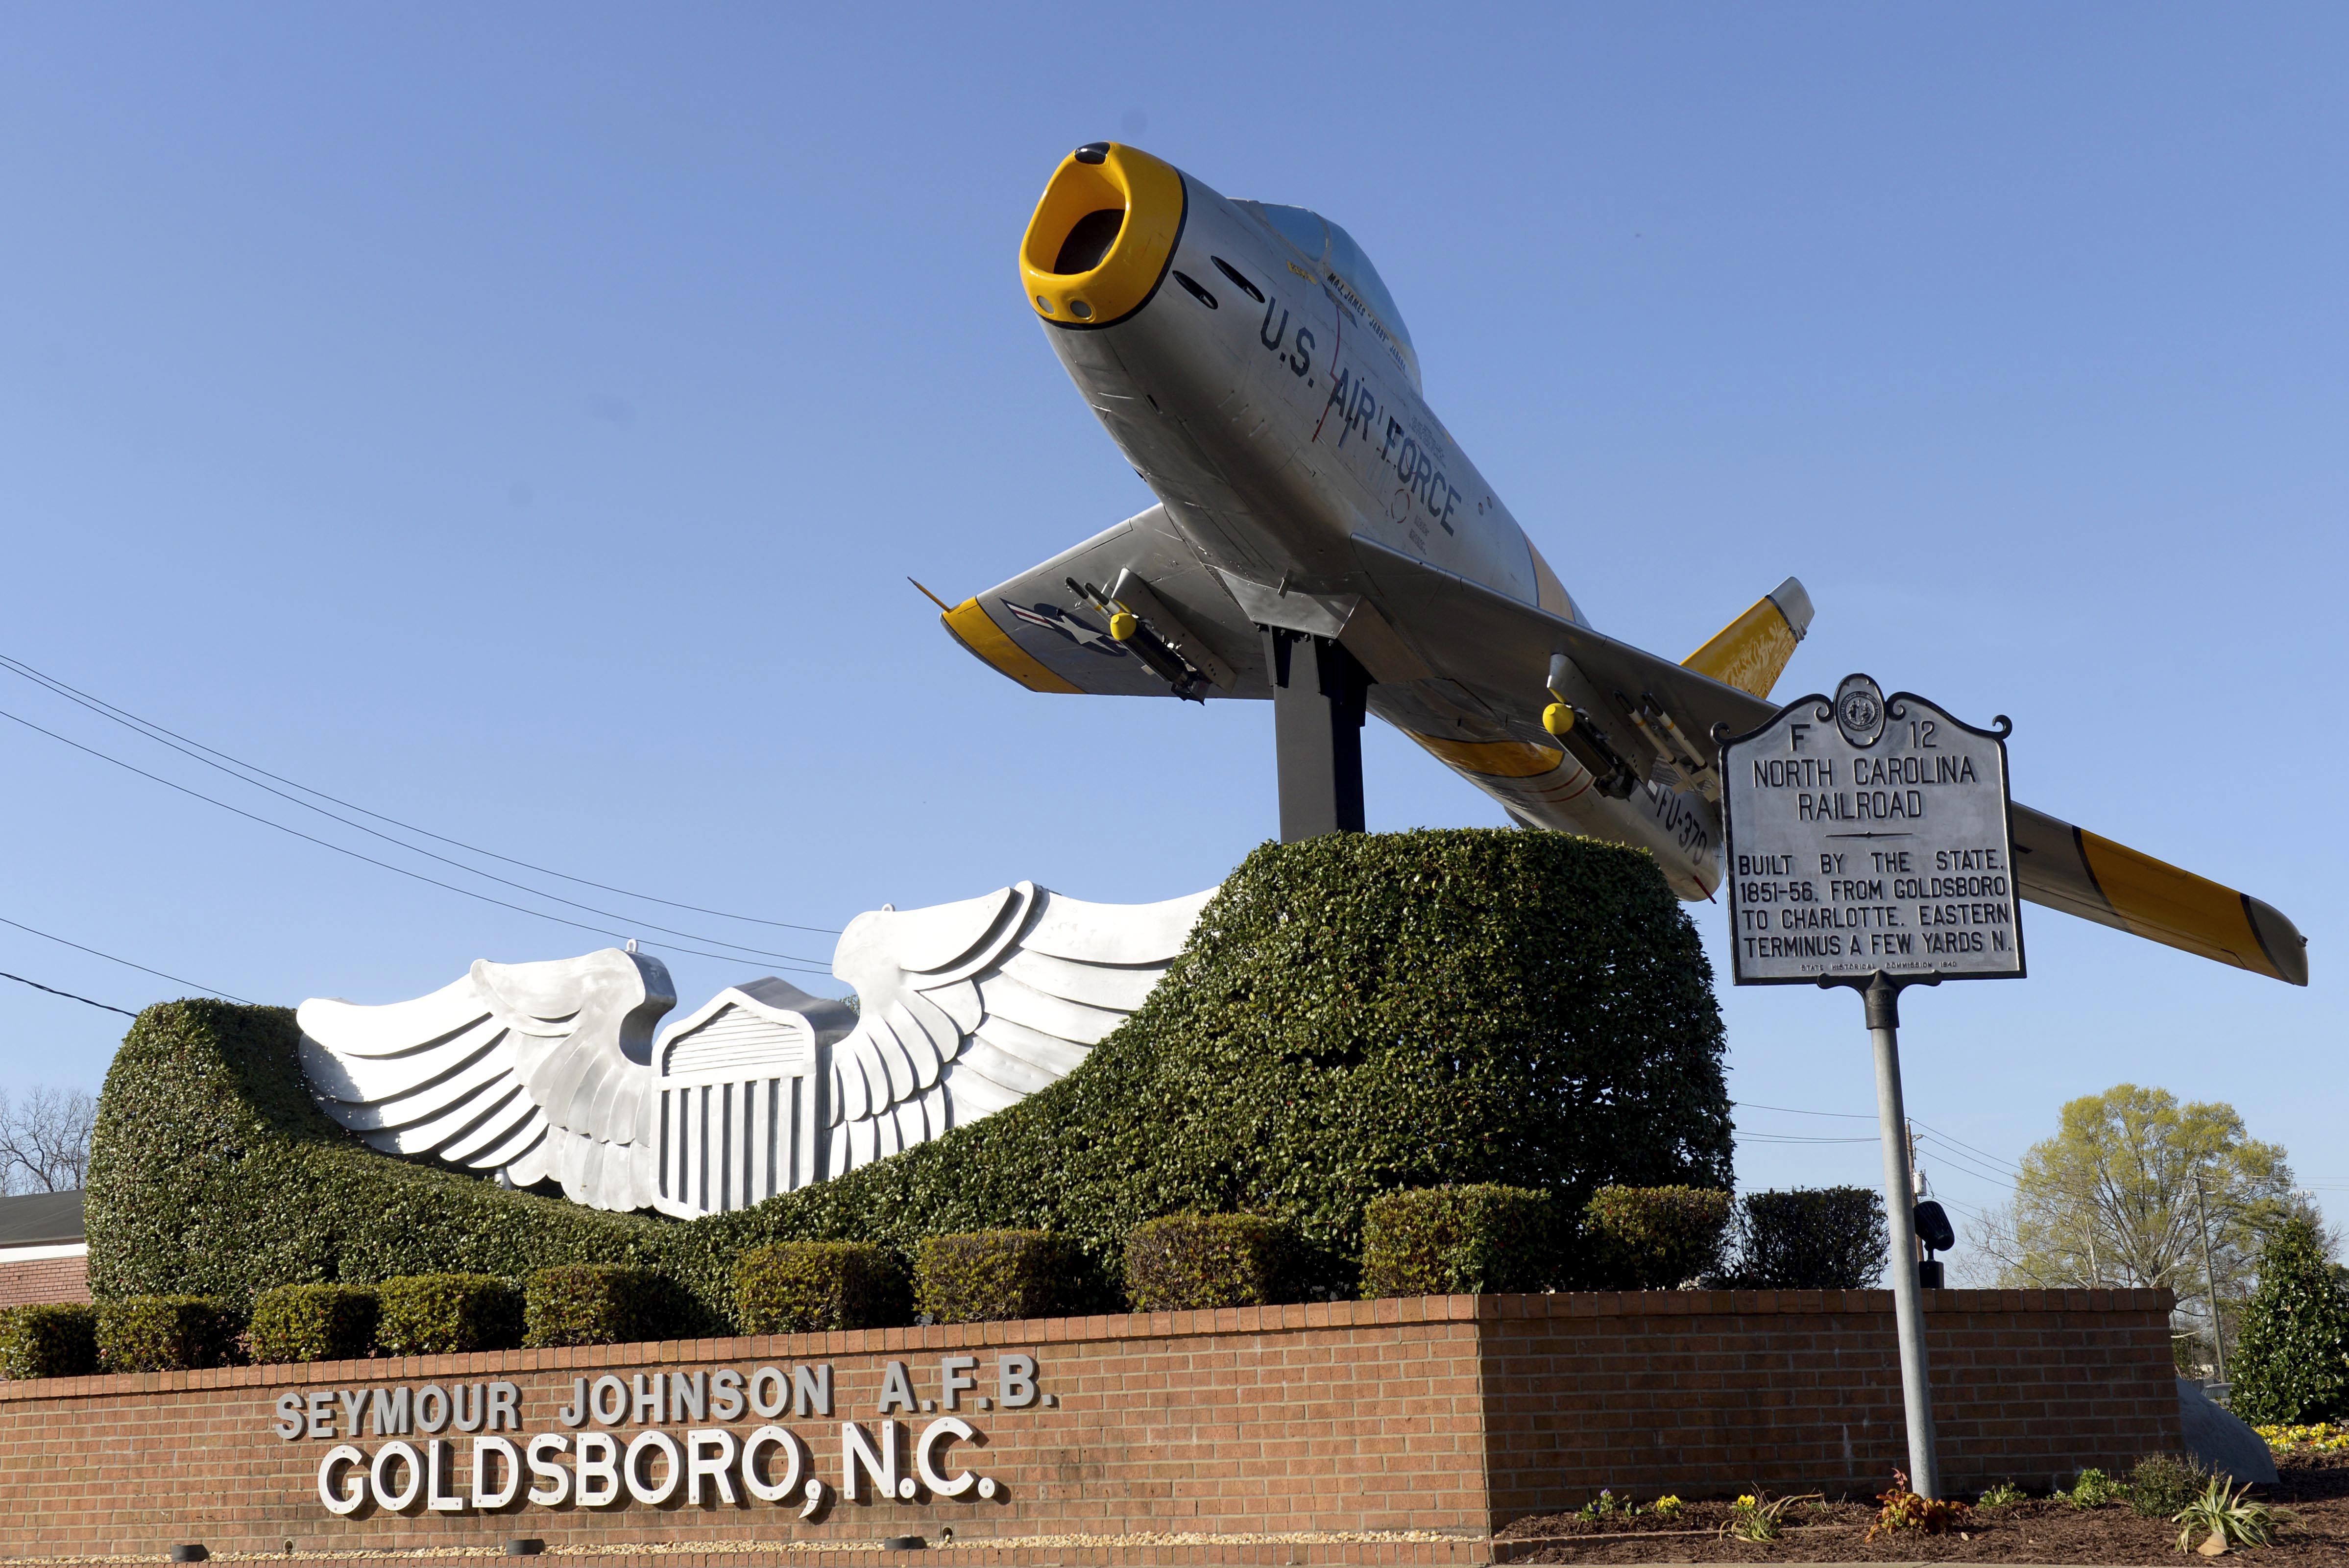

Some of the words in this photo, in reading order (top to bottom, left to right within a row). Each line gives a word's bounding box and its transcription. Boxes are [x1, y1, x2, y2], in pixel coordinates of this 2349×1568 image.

[1344, 291, 1366, 316] JAMES
[1260, 296, 1316, 388] U.S.
[1328, 367, 1376, 441] AIR
[1380, 415, 1462, 537] FORCE
[1790, 724, 1811, 751] F
[1910, 721, 1937, 748] 12
[1753, 758, 1833, 788] NORTH
[1853, 755, 1976, 786] CAROLINA
[1798, 790, 1922, 821] RAILROAD
[1656, 789, 1707, 866] FU-370
[1739, 855, 1792, 876] BUILT
[1819, 853, 1844, 874] BY
[1870, 851, 1911, 872] THE
[1936, 849, 2004, 871] STATE,
[1740, 882, 1819, 904] 1851-56,
[1831, 879, 1883, 901] FROM
[1893, 876, 2006, 899] GOLDSBORO
[1742, 910, 1768, 930] TO
[1781, 906, 1905, 929] CHARLOTTE.
[1918, 903, 2009, 926] EASTERN
[1744, 936, 1841, 958] TERMINUS
[1850, 936, 1863, 956] A
[1870, 933, 1912, 955] FEW
[1923, 932, 1983, 953] YARDS
[1991, 931, 2011, 951] N.
[275, 1382, 522, 1441] SEYMOUR
[559, 1364, 830, 1427] JOHNSON
[878, 1354, 1056, 1413] A.F.B.
[316, 1426, 825, 1518] GOLDSBORO,
[841, 1418, 997, 1500] N.C.
